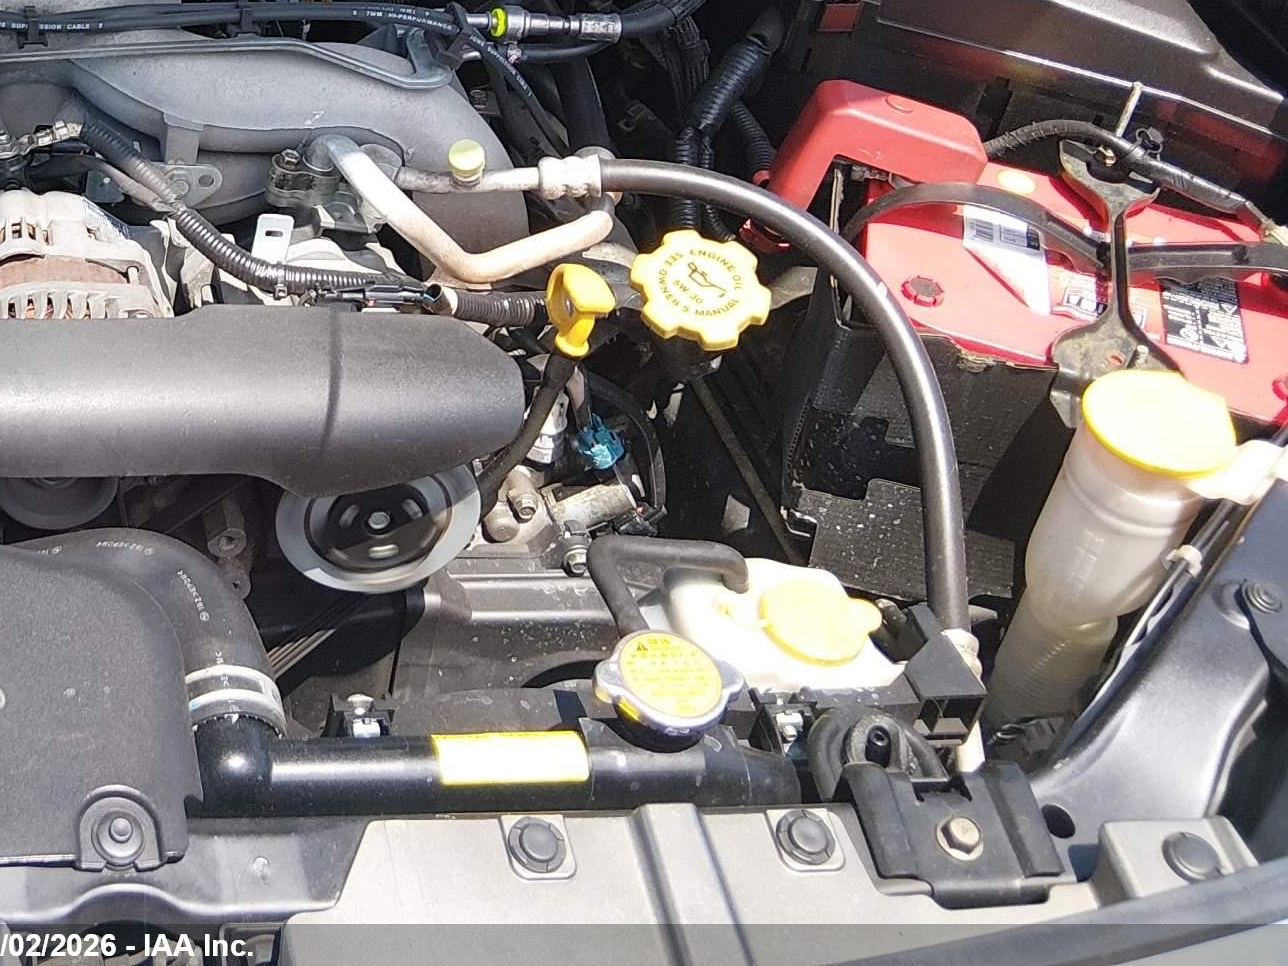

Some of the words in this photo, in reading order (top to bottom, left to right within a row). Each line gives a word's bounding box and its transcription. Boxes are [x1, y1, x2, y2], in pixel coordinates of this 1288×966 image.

[388, 11, 454, 31] HI-PERFORMANCE
[663, 252, 684, 267] SEE
[695, 298, 741, 316] MANUAL
[689, 249, 736, 272] ENGINE
[732, 274, 745, 291] OIL
